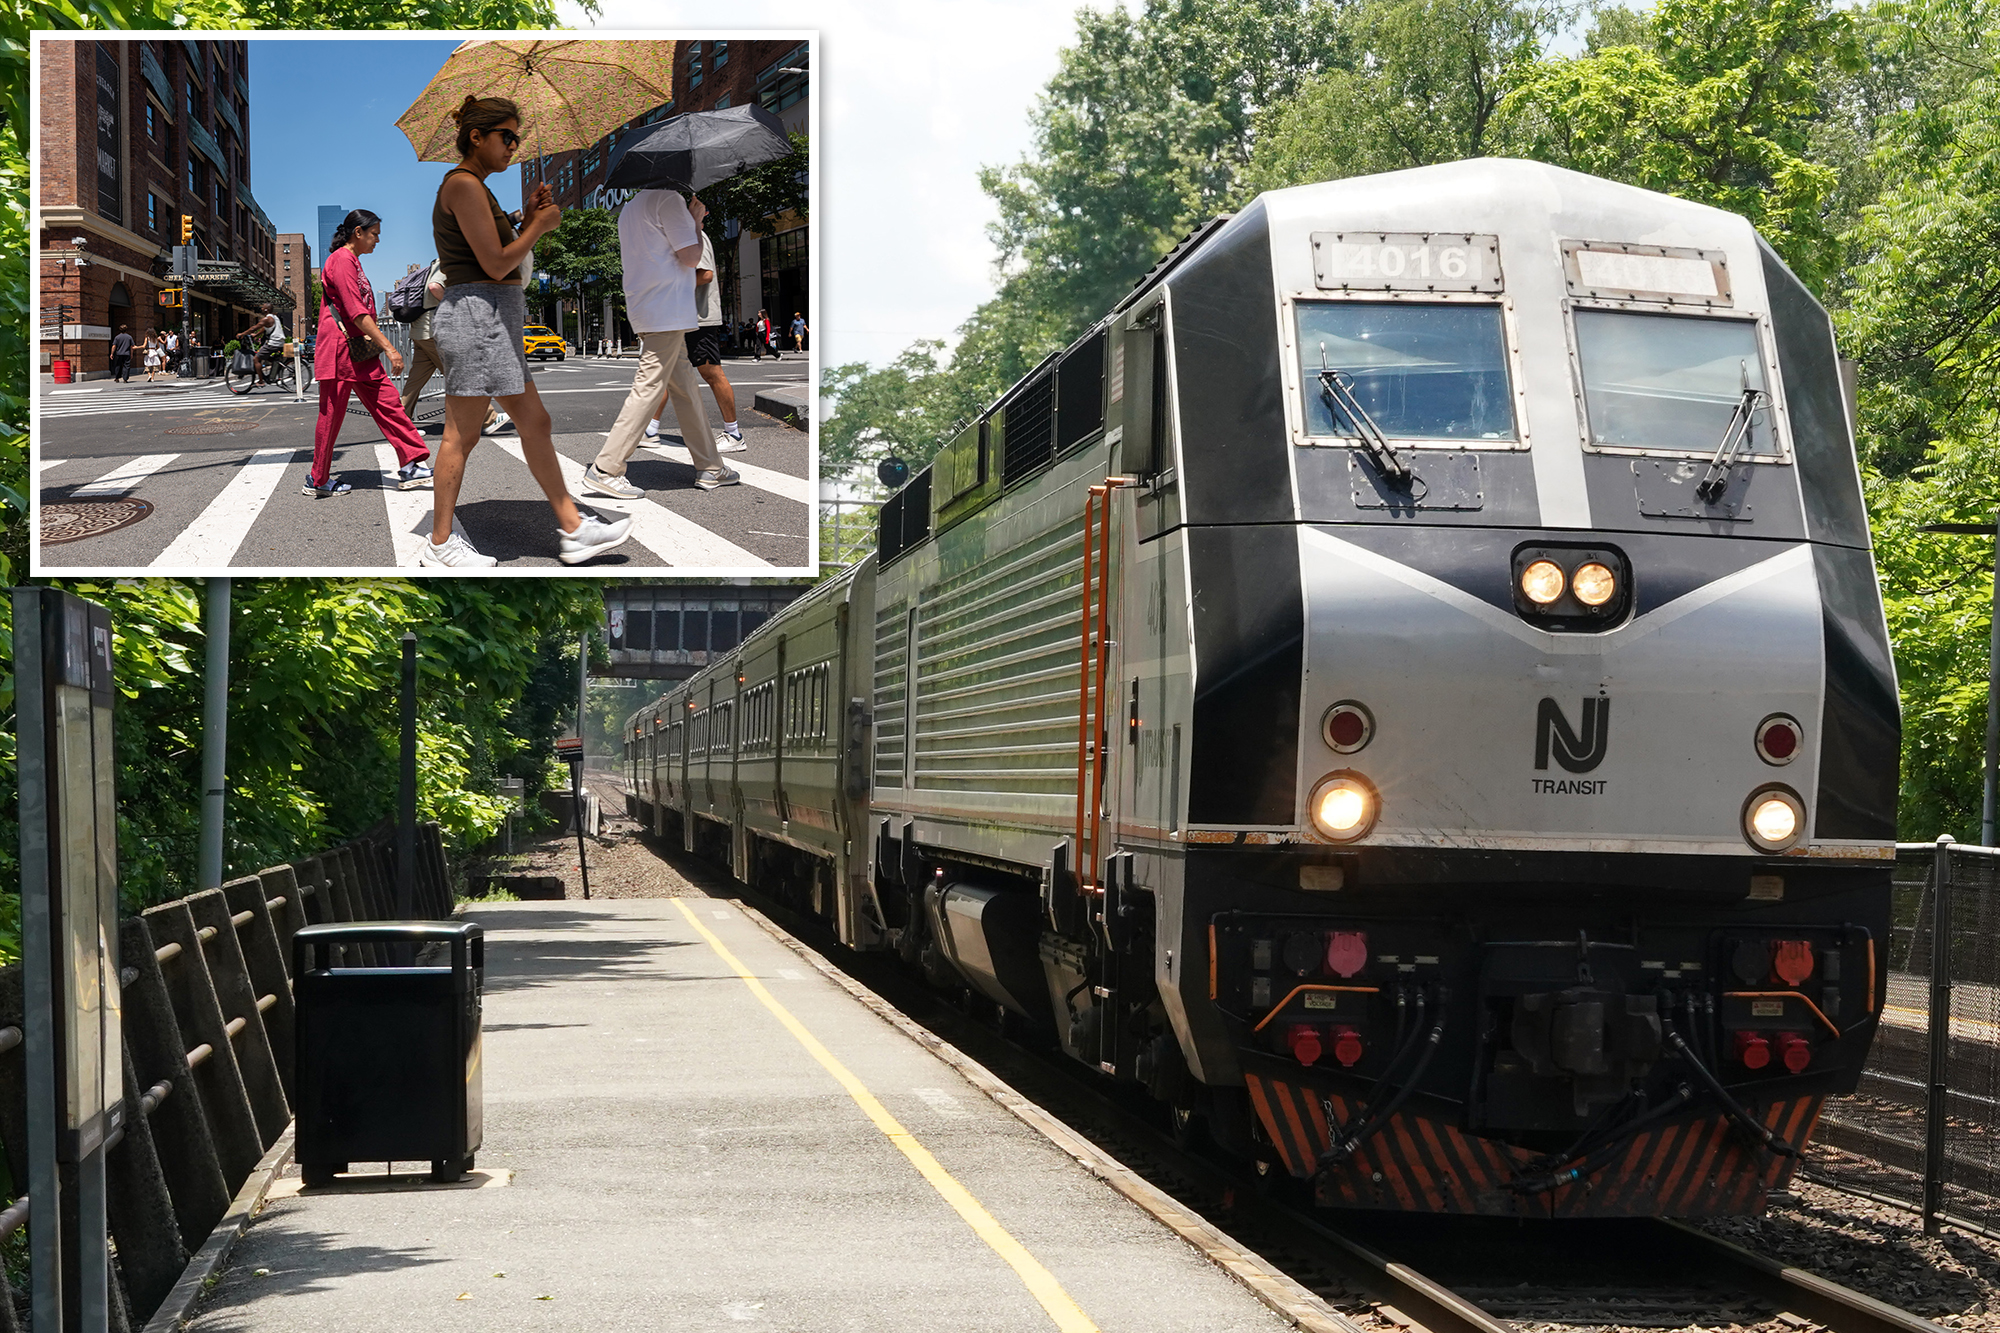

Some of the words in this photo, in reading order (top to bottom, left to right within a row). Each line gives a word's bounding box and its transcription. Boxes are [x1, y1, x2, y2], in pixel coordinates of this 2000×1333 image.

[1348, 245, 1468, 278] 4016
[1534, 696, 1610, 774] NJ
[1532, 779, 1607, 795] TRANSIT
